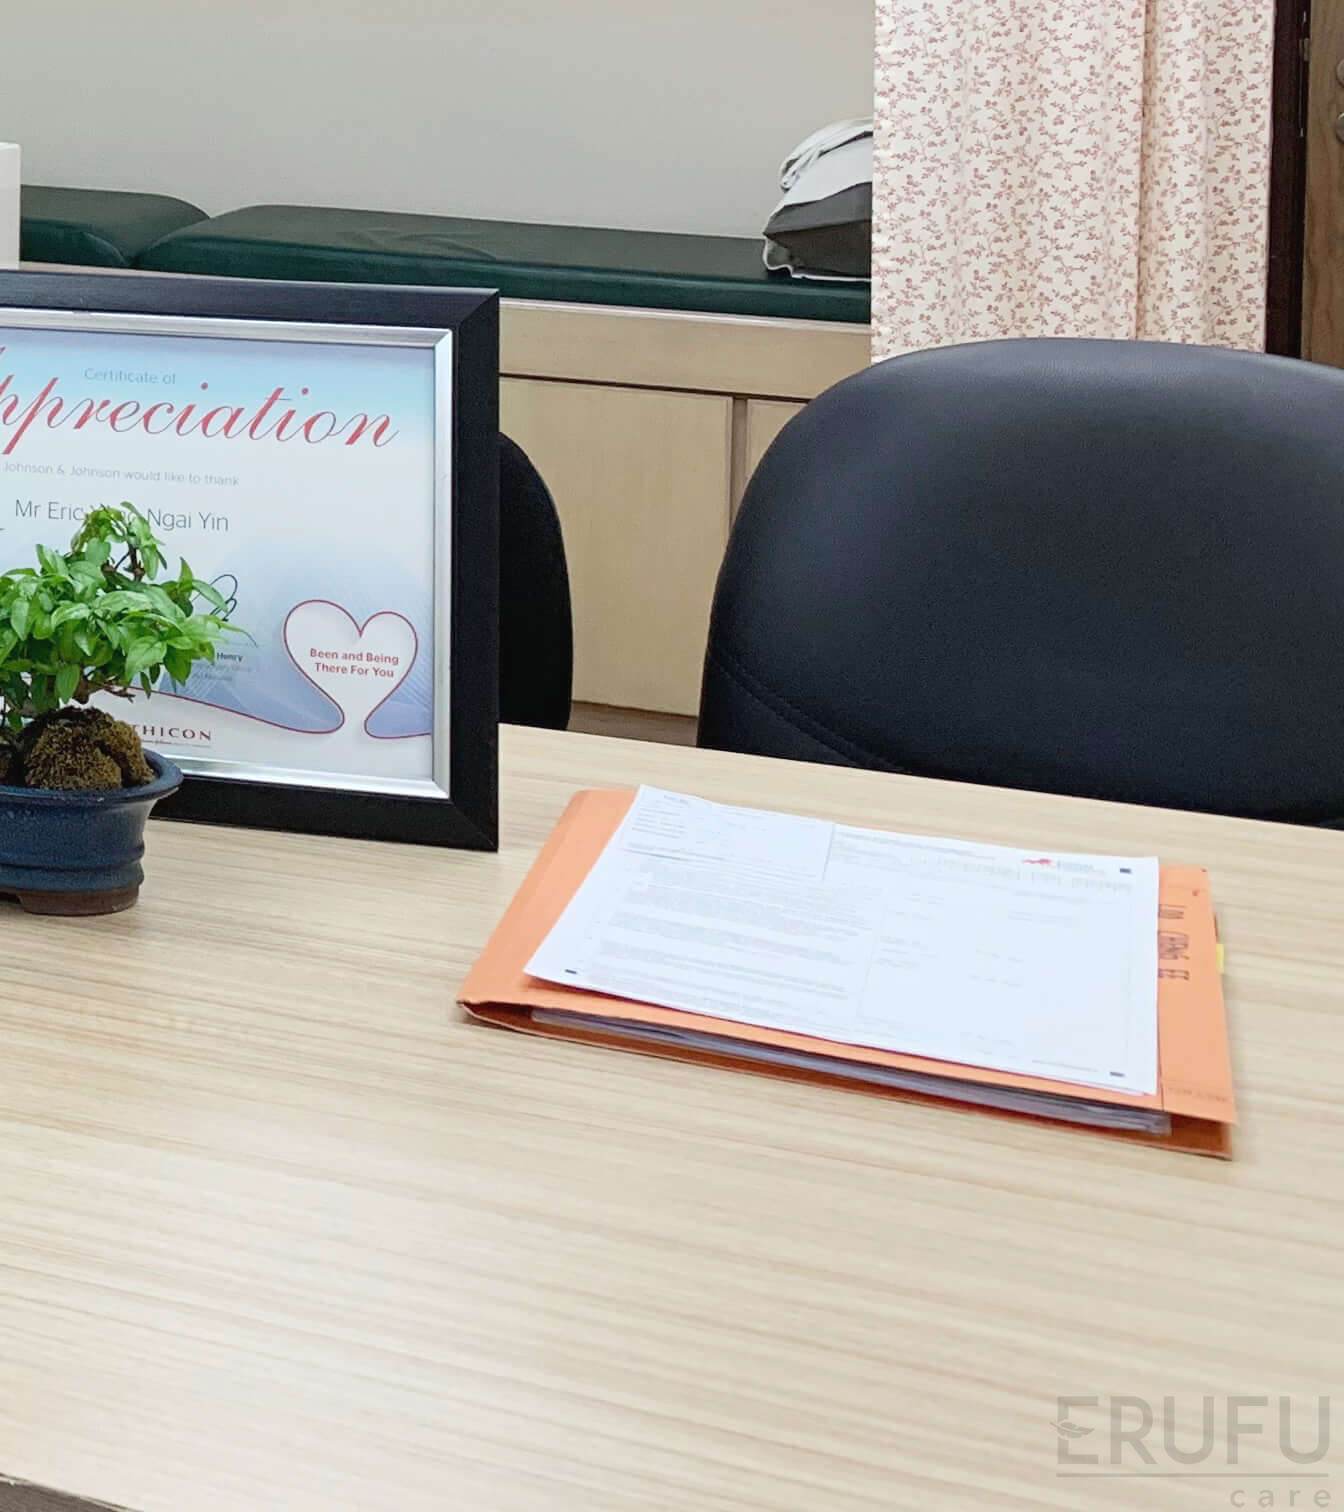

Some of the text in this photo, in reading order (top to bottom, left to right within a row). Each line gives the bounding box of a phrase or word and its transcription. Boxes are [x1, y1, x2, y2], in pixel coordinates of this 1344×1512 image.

[83, 367, 177, 385] Certificate of
[2, 461, 240, 486] Johnson & Johnson would like to thank
[14, 498, 42, 519] Mr
[47, 500, 84, 522] Eric
[147, 507, 192, 531] Ngai
[198, 511, 229, 532] Yin
[216, 651, 244, 663] Henry
[309, 648, 400, 666] Been and Being
[314, 662, 395, 678] There For You
[134, 723, 211, 741] HICON
